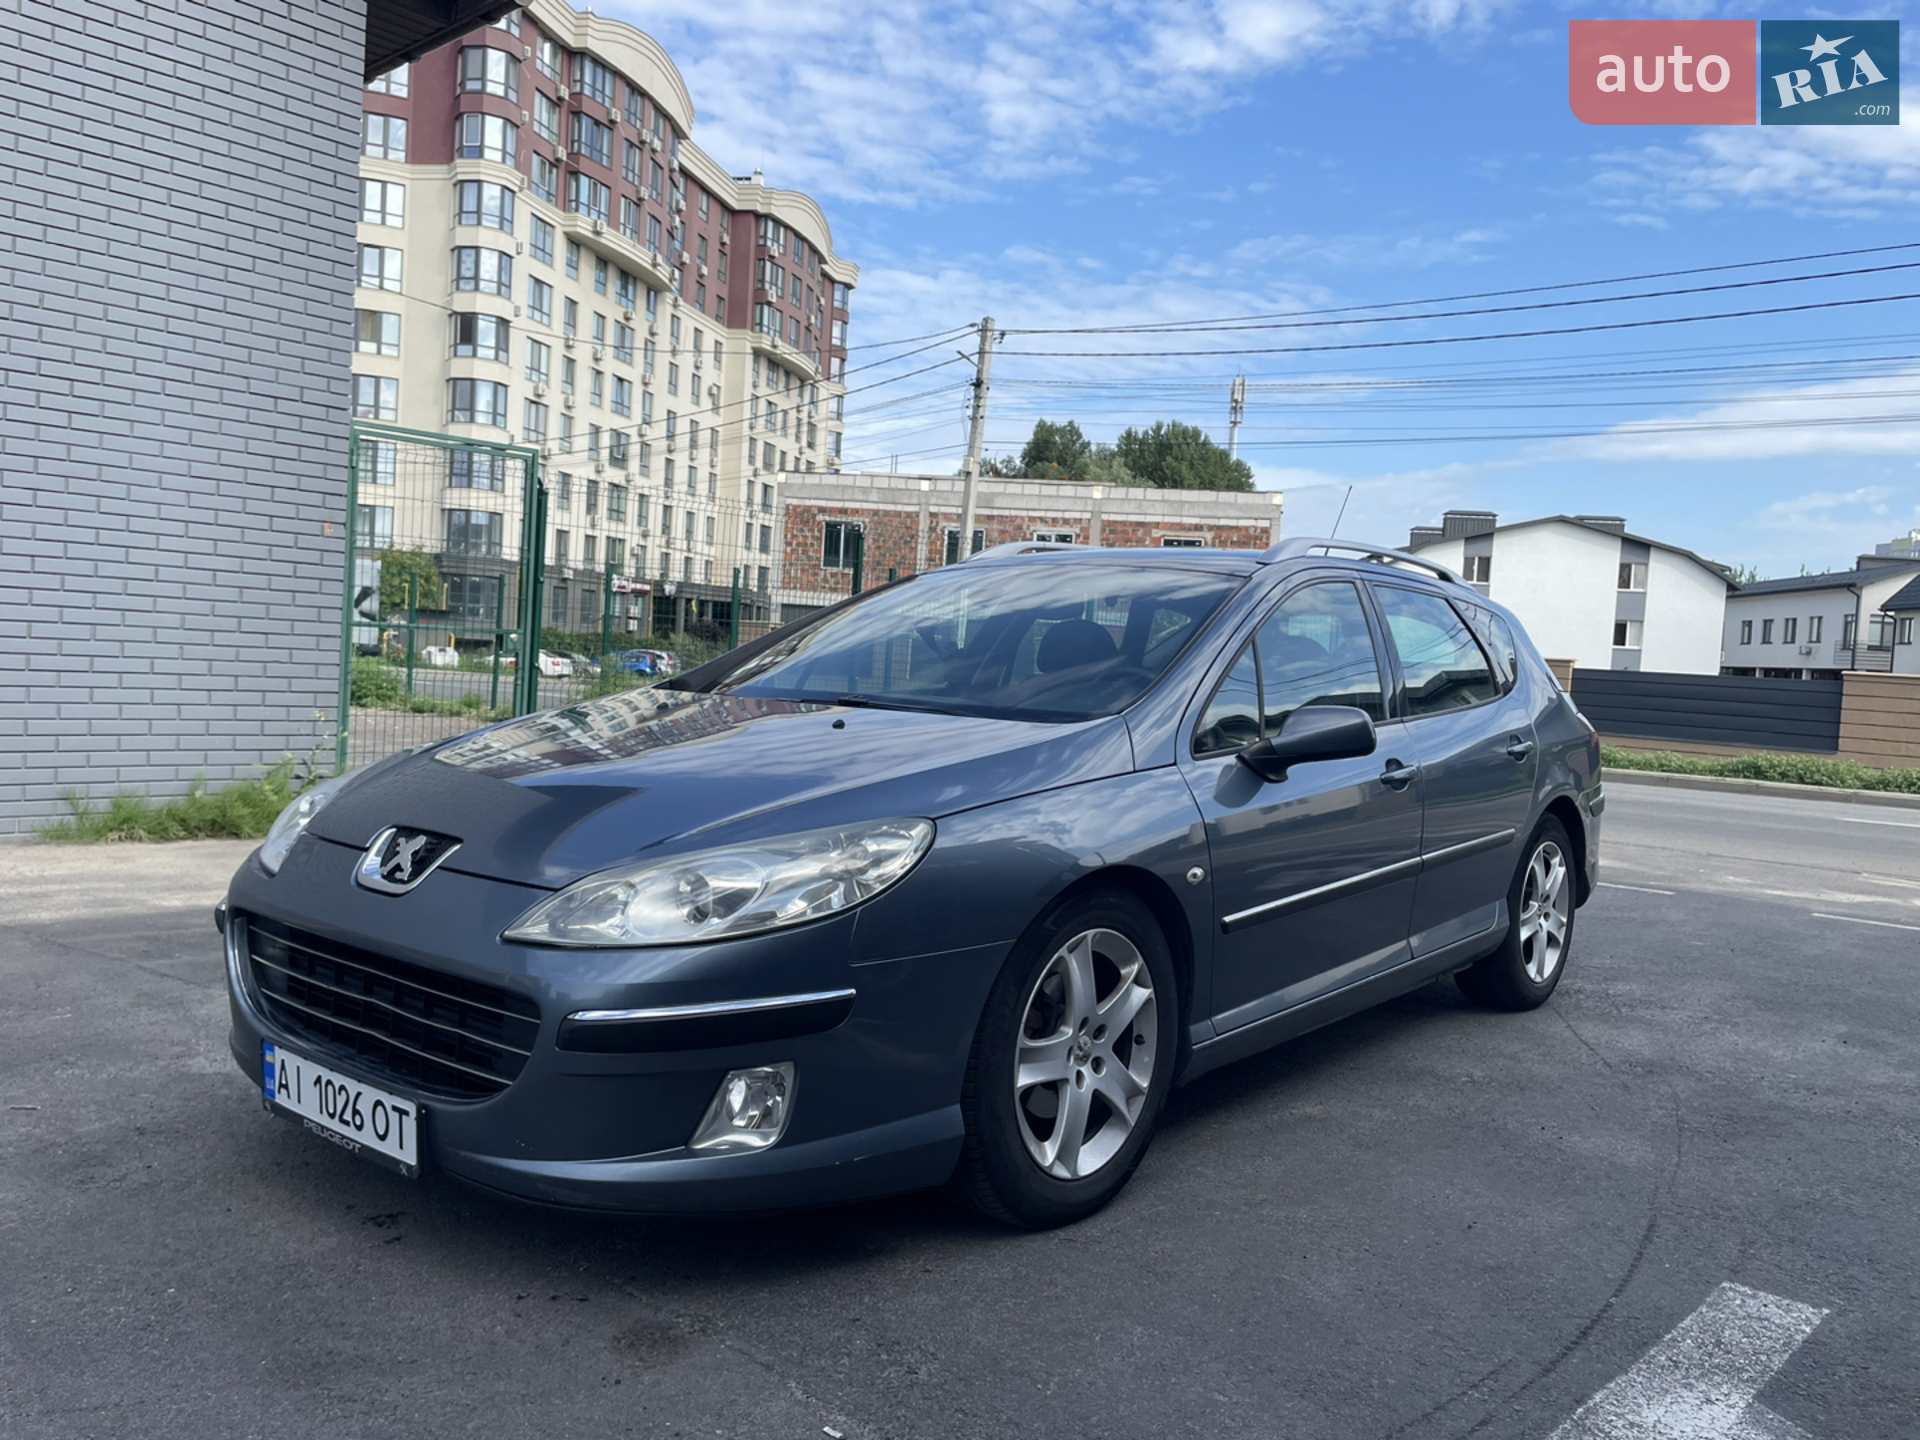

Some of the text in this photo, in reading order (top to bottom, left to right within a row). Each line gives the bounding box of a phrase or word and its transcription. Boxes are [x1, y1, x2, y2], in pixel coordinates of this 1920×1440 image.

[277, 1058, 410, 1150] AI 1026 OT
[303, 1119, 362, 1153] PEUGEOT
